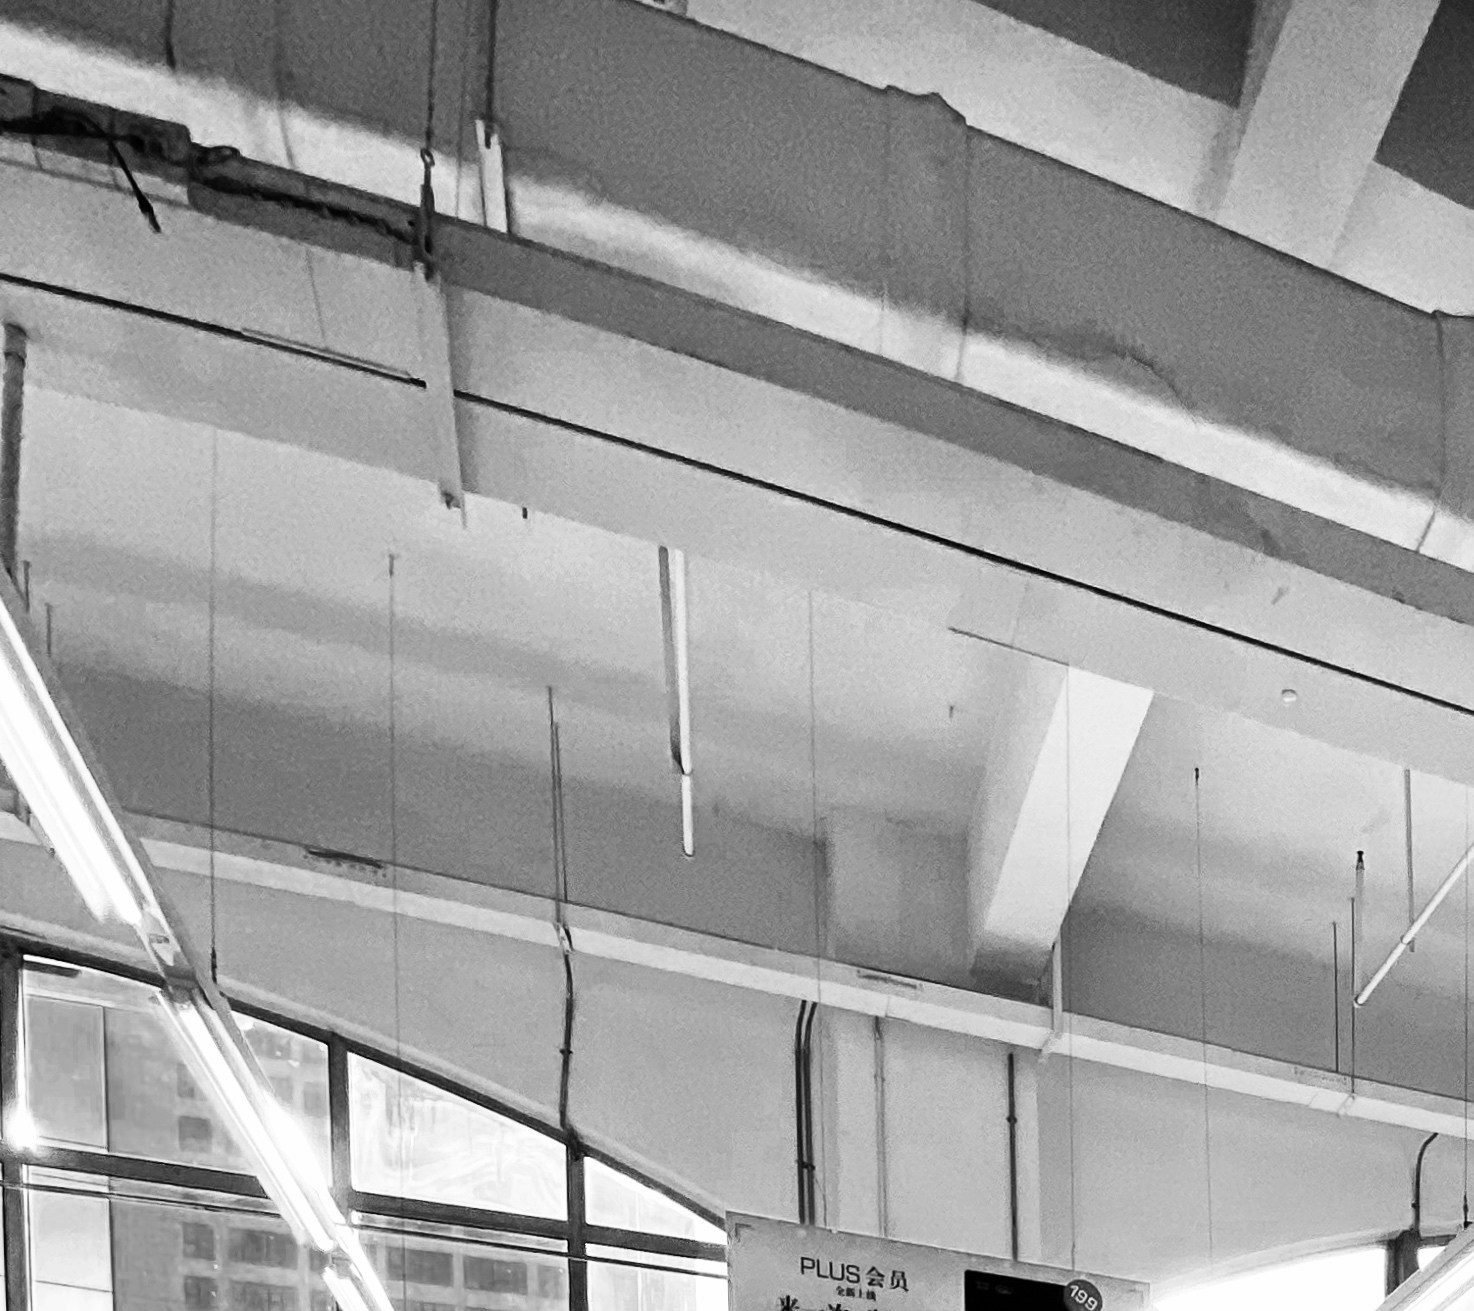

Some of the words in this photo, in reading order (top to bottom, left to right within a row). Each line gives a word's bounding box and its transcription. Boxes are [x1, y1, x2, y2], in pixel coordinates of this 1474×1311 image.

[801, 1256, 861, 1284] PLUS
[865, 1266, 909, 1292] 会员
[1070, 1284, 1099, 1311] 199
